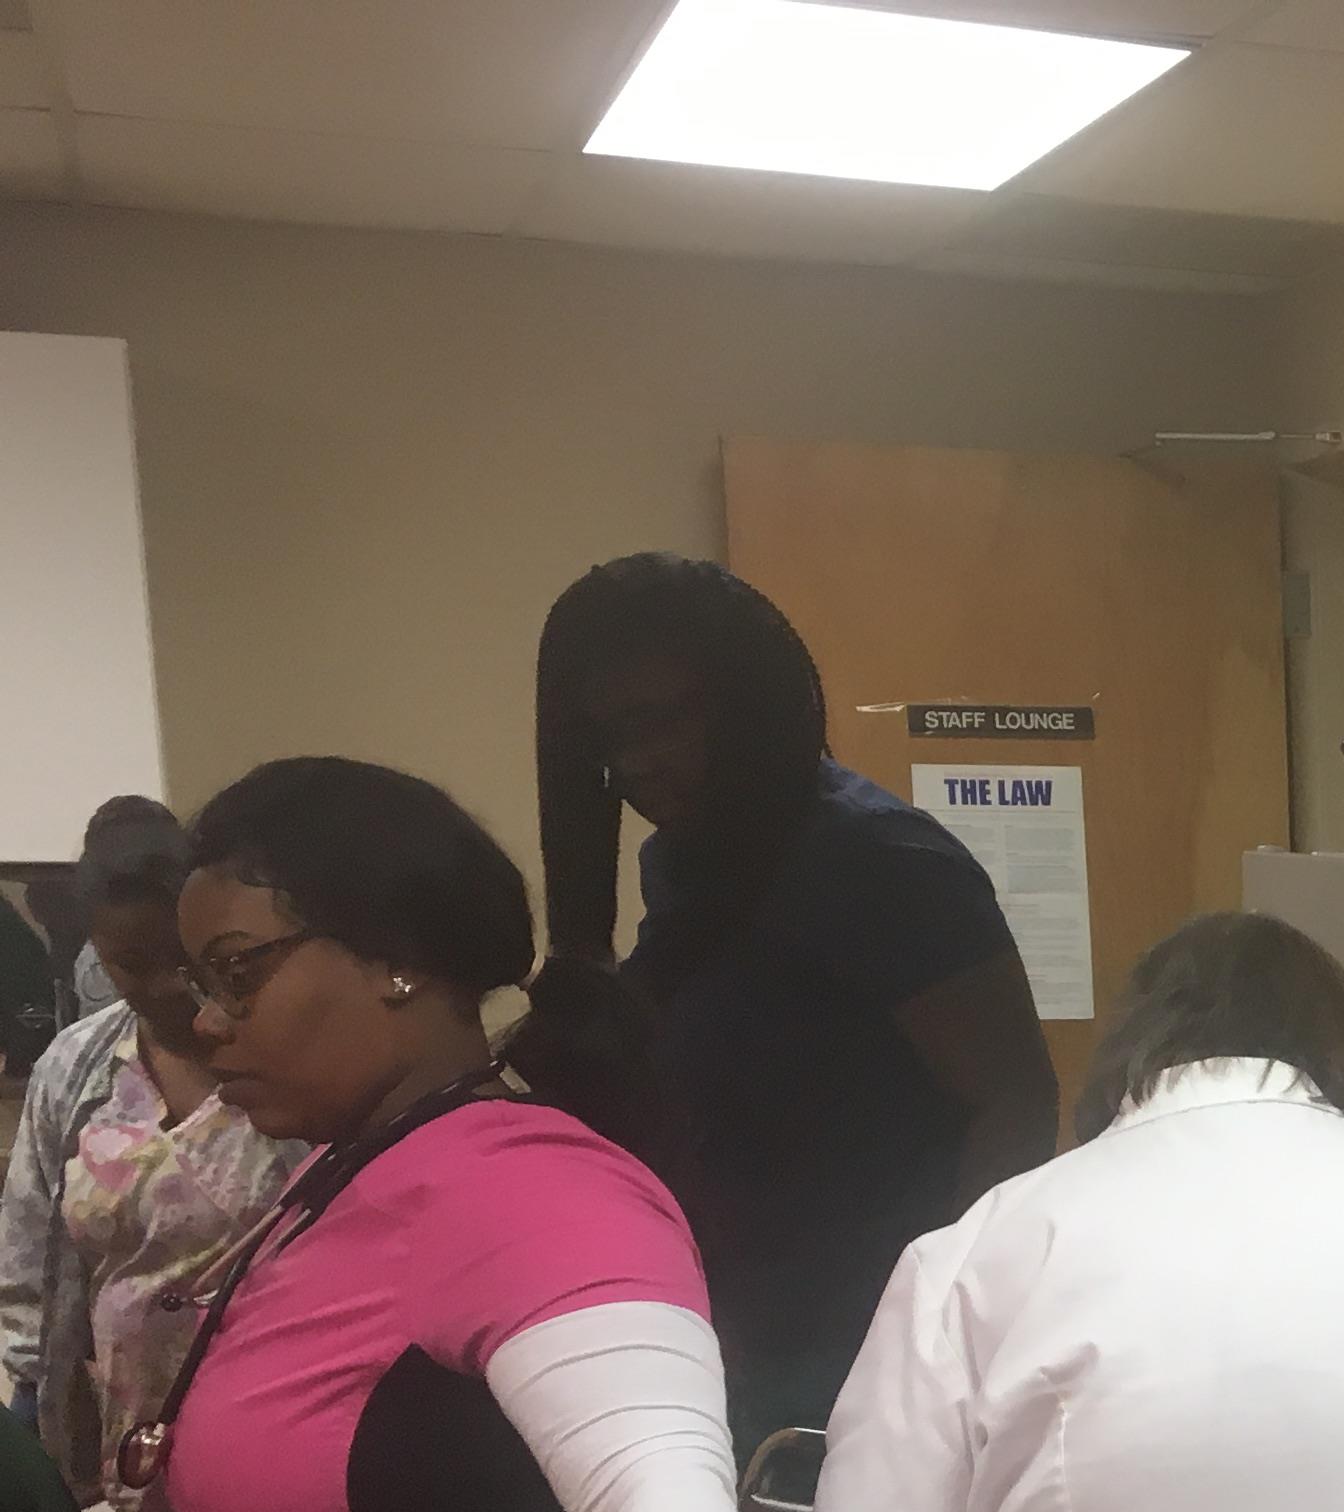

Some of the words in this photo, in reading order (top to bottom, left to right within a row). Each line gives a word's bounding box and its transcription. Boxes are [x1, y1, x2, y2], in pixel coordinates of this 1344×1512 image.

[924, 710, 985, 729] STAFF
[995, 712, 1075, 730] LOUNGE
[944, 778, 991, 806] THE
[998, 780, 1052, 806] LAW
